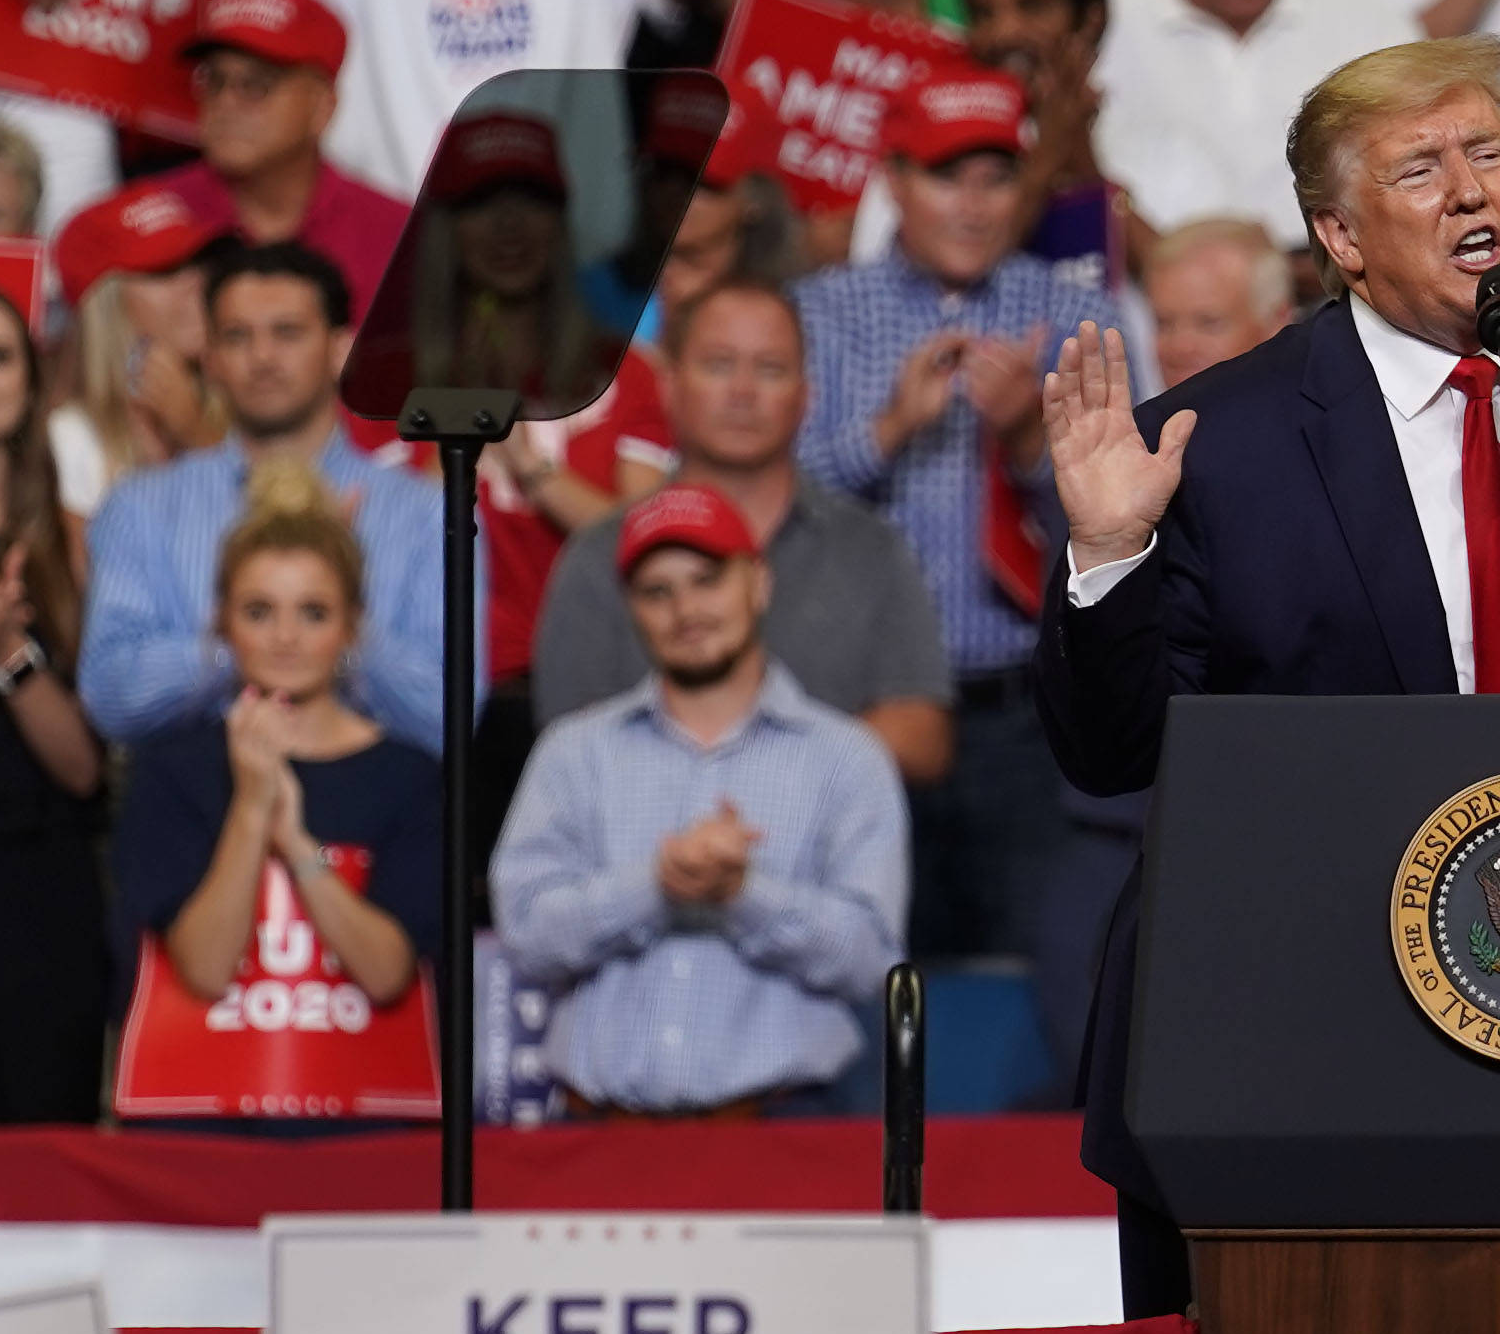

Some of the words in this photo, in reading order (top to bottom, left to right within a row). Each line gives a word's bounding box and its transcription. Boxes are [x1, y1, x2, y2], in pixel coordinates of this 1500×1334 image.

[1404, 922, 1427, 963] THE
[1416, 966, 1440, 992] OF
[204, 978, 373, 1035] 2020
